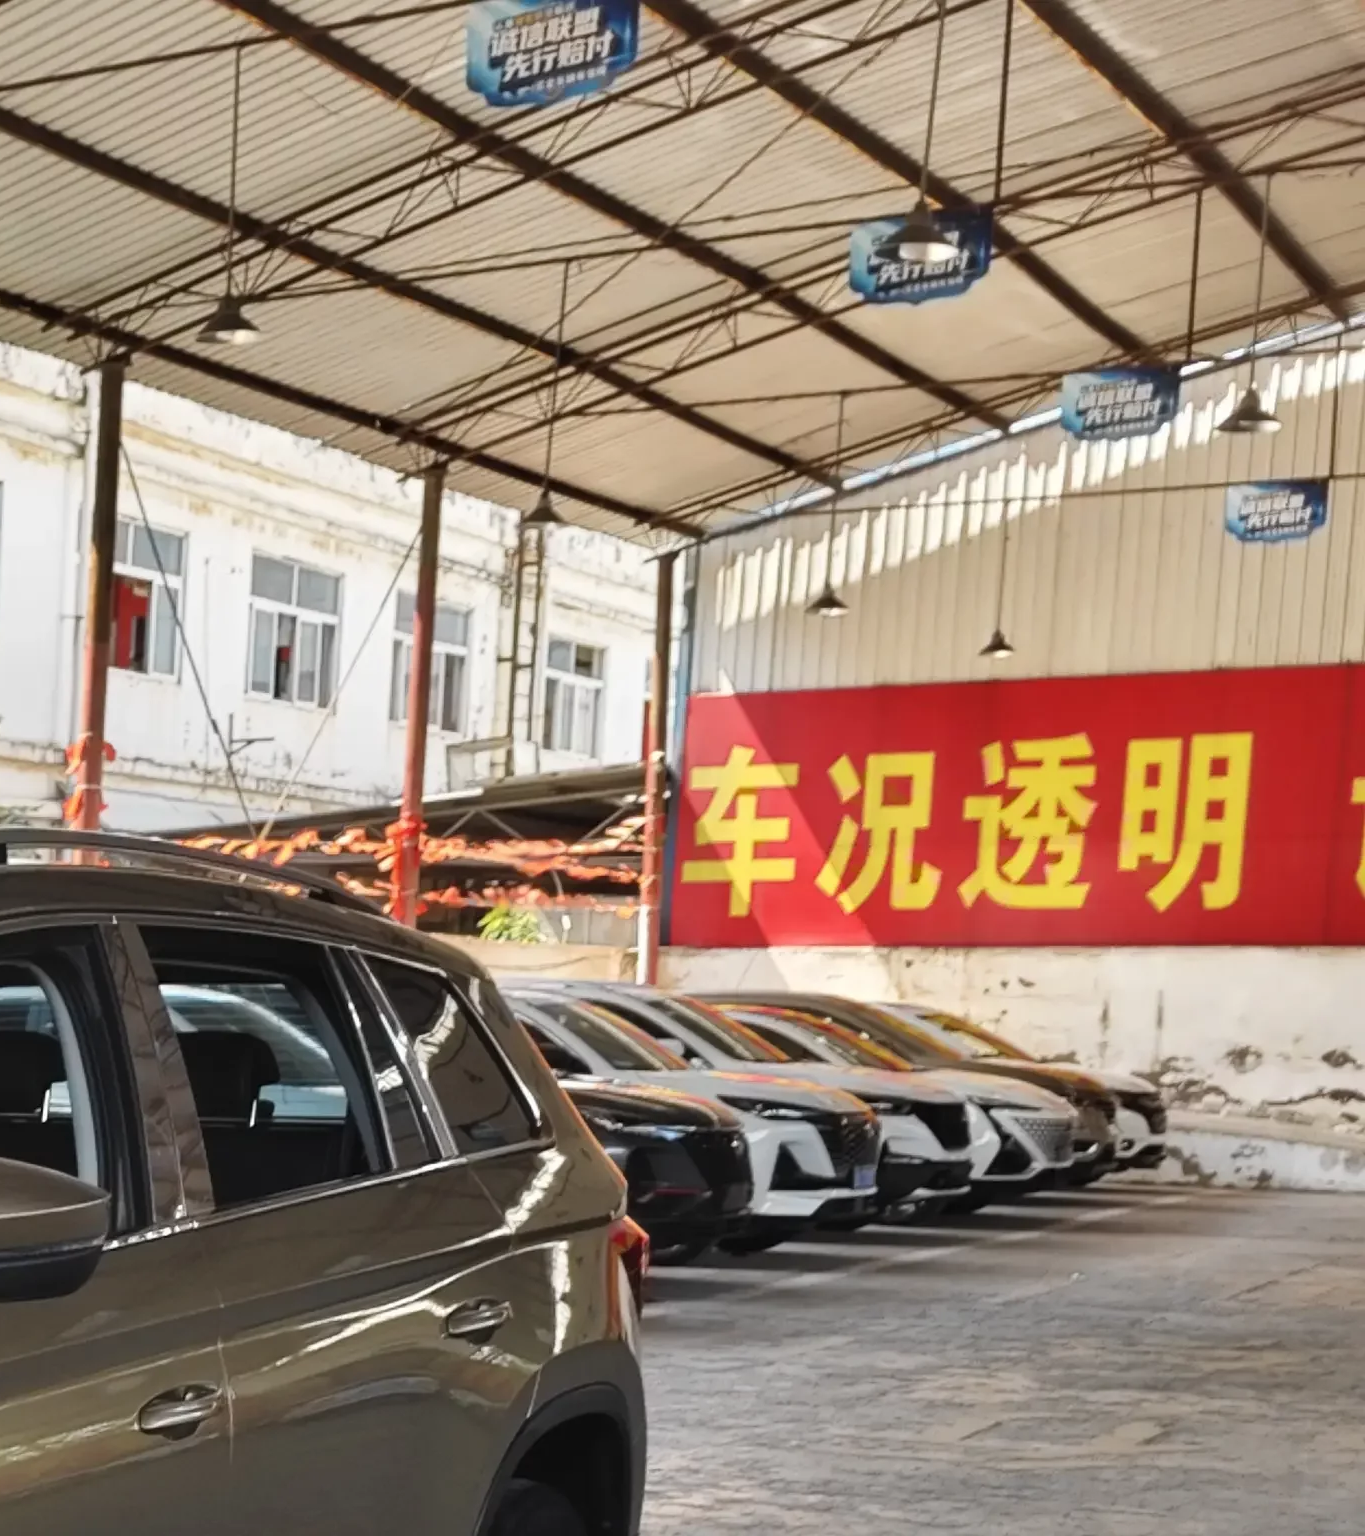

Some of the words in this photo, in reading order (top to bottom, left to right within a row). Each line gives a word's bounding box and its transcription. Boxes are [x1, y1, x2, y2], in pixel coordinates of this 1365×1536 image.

[489, 6, 600, 57] 诚信联盟
[503, 29, 614, 83] 先行赔付
[681, 731, 1254, 918] 车况透明
